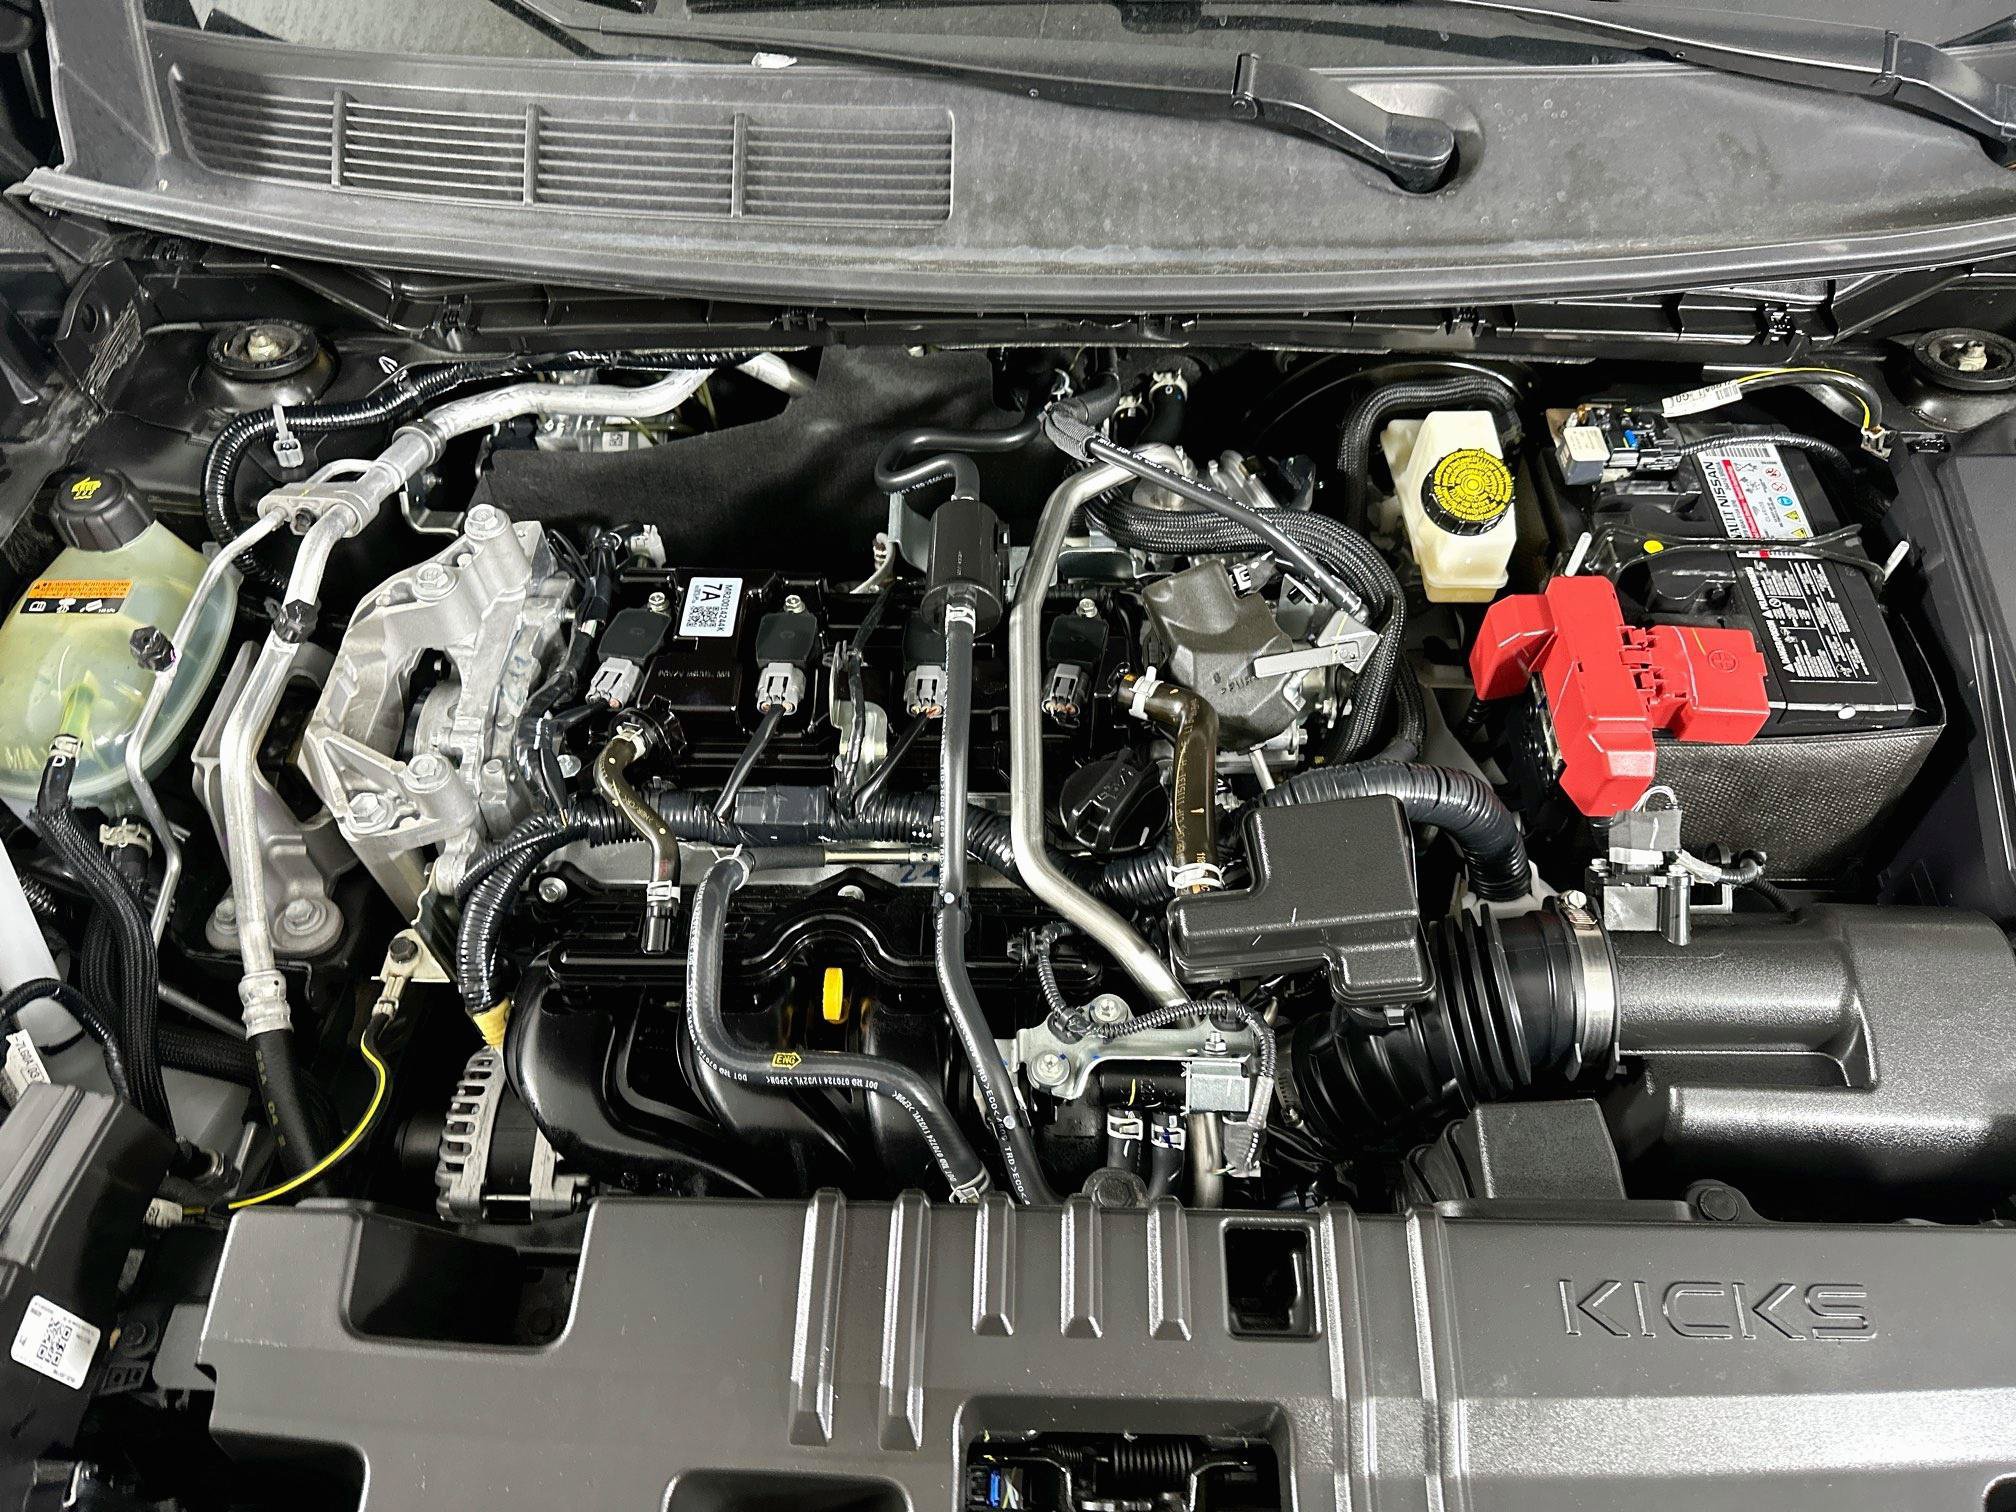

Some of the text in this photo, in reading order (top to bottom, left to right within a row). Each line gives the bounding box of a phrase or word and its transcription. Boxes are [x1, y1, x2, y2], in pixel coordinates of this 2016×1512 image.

[1703, 461, 1731, 508] NISSAN
[700, 583, 724, 602] 7A
[866, 1081, 879, 1090] DOT
[1557, 1278, 1878, 1341] KICKS
